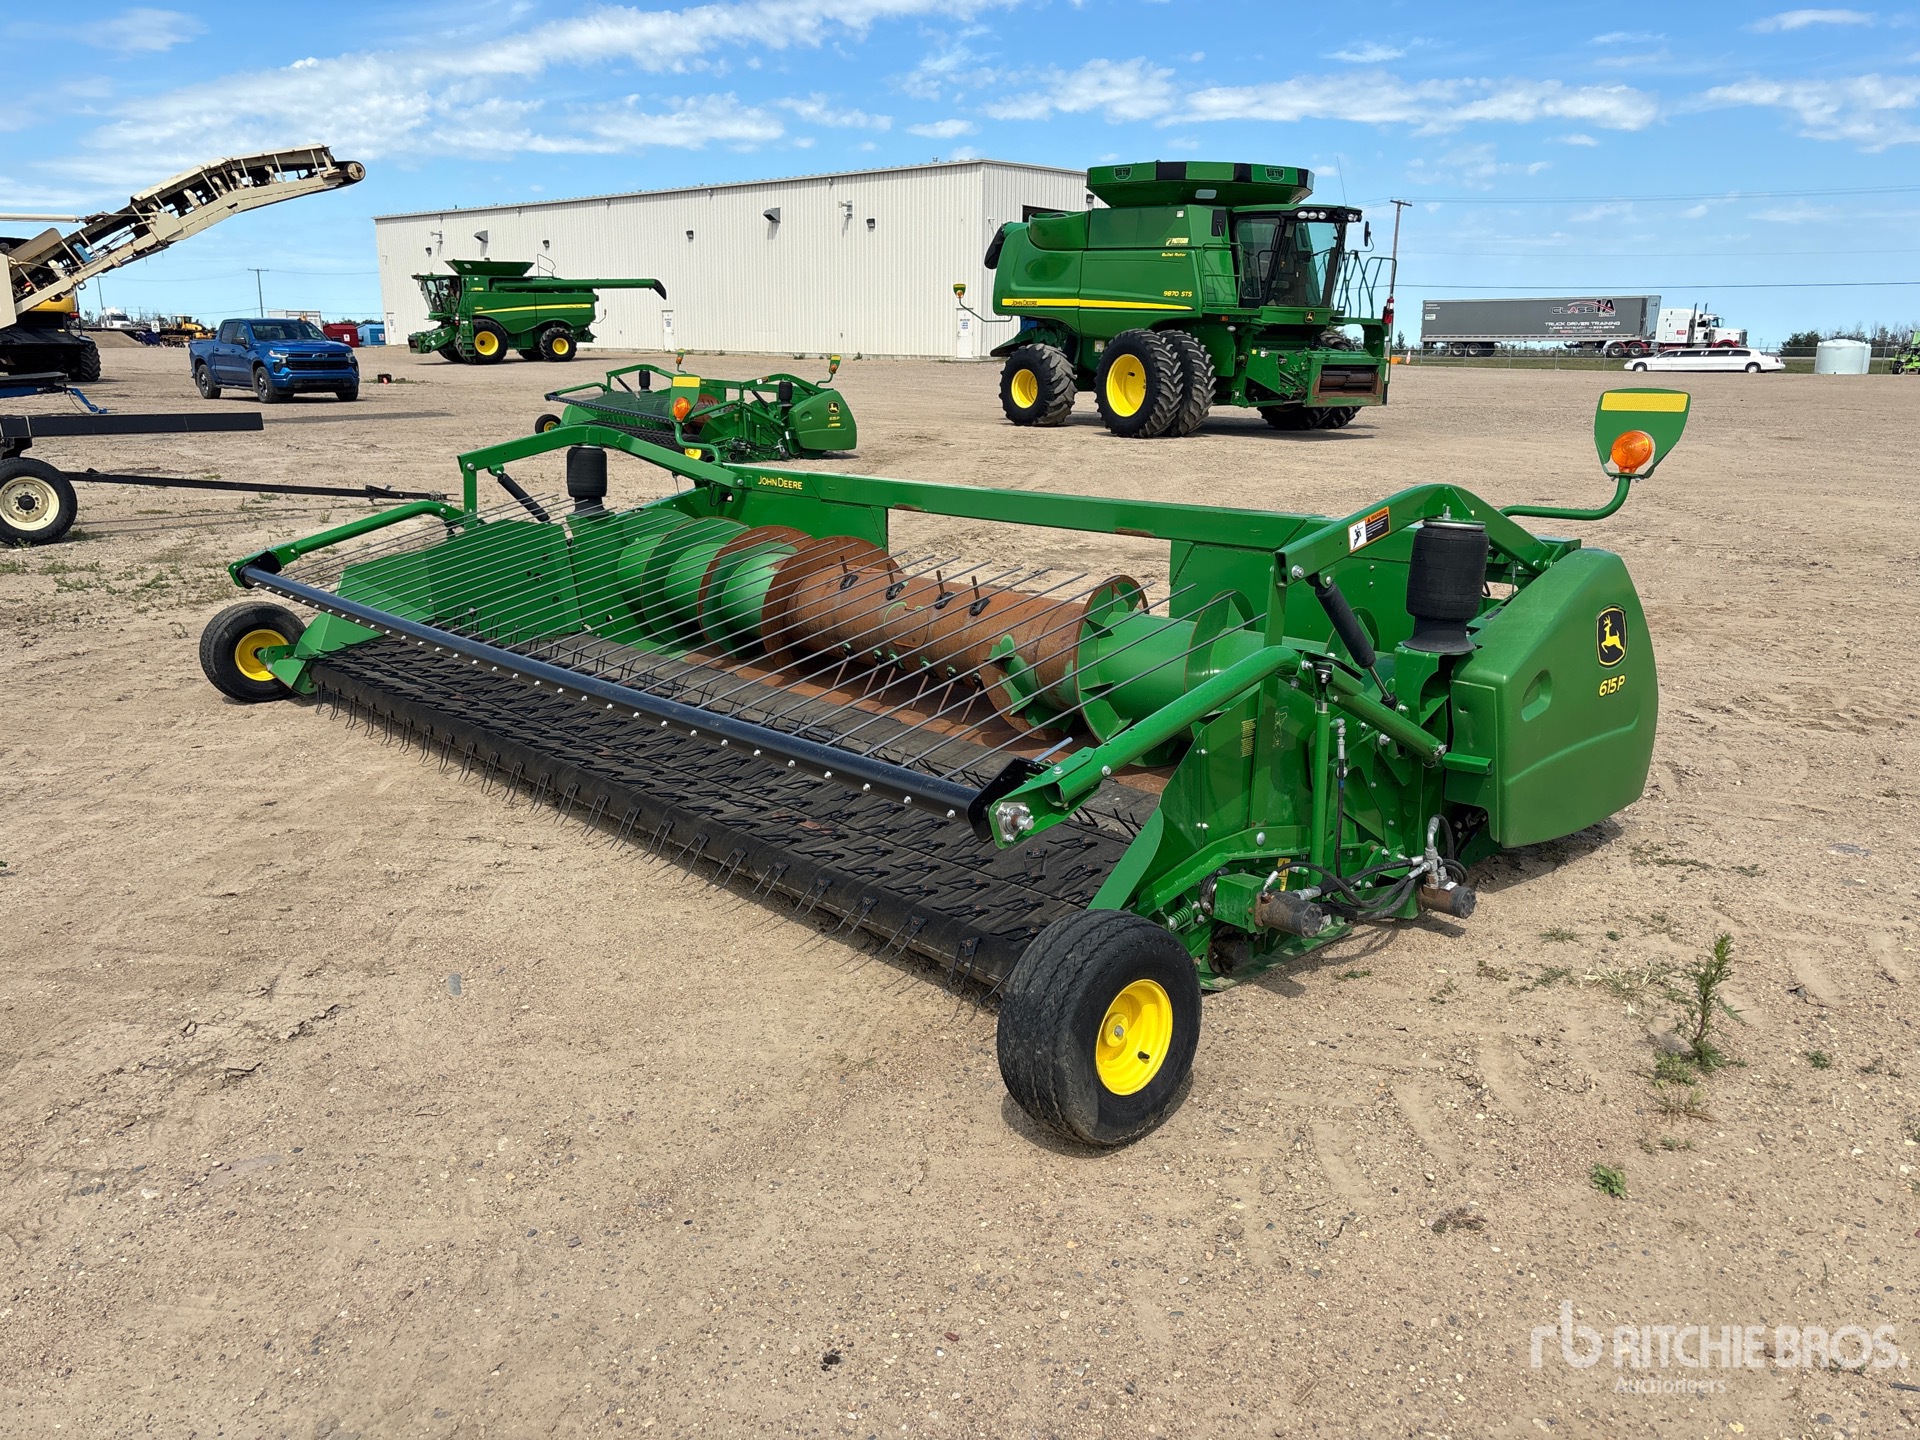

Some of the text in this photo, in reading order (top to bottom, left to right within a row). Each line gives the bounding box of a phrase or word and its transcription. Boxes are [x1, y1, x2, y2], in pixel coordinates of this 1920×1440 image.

[1552, 306, 1595, 315] CLASS
[758, 475, 803, 490] JOHN DEERE
[1598, 674, 1626, 697] 615P
